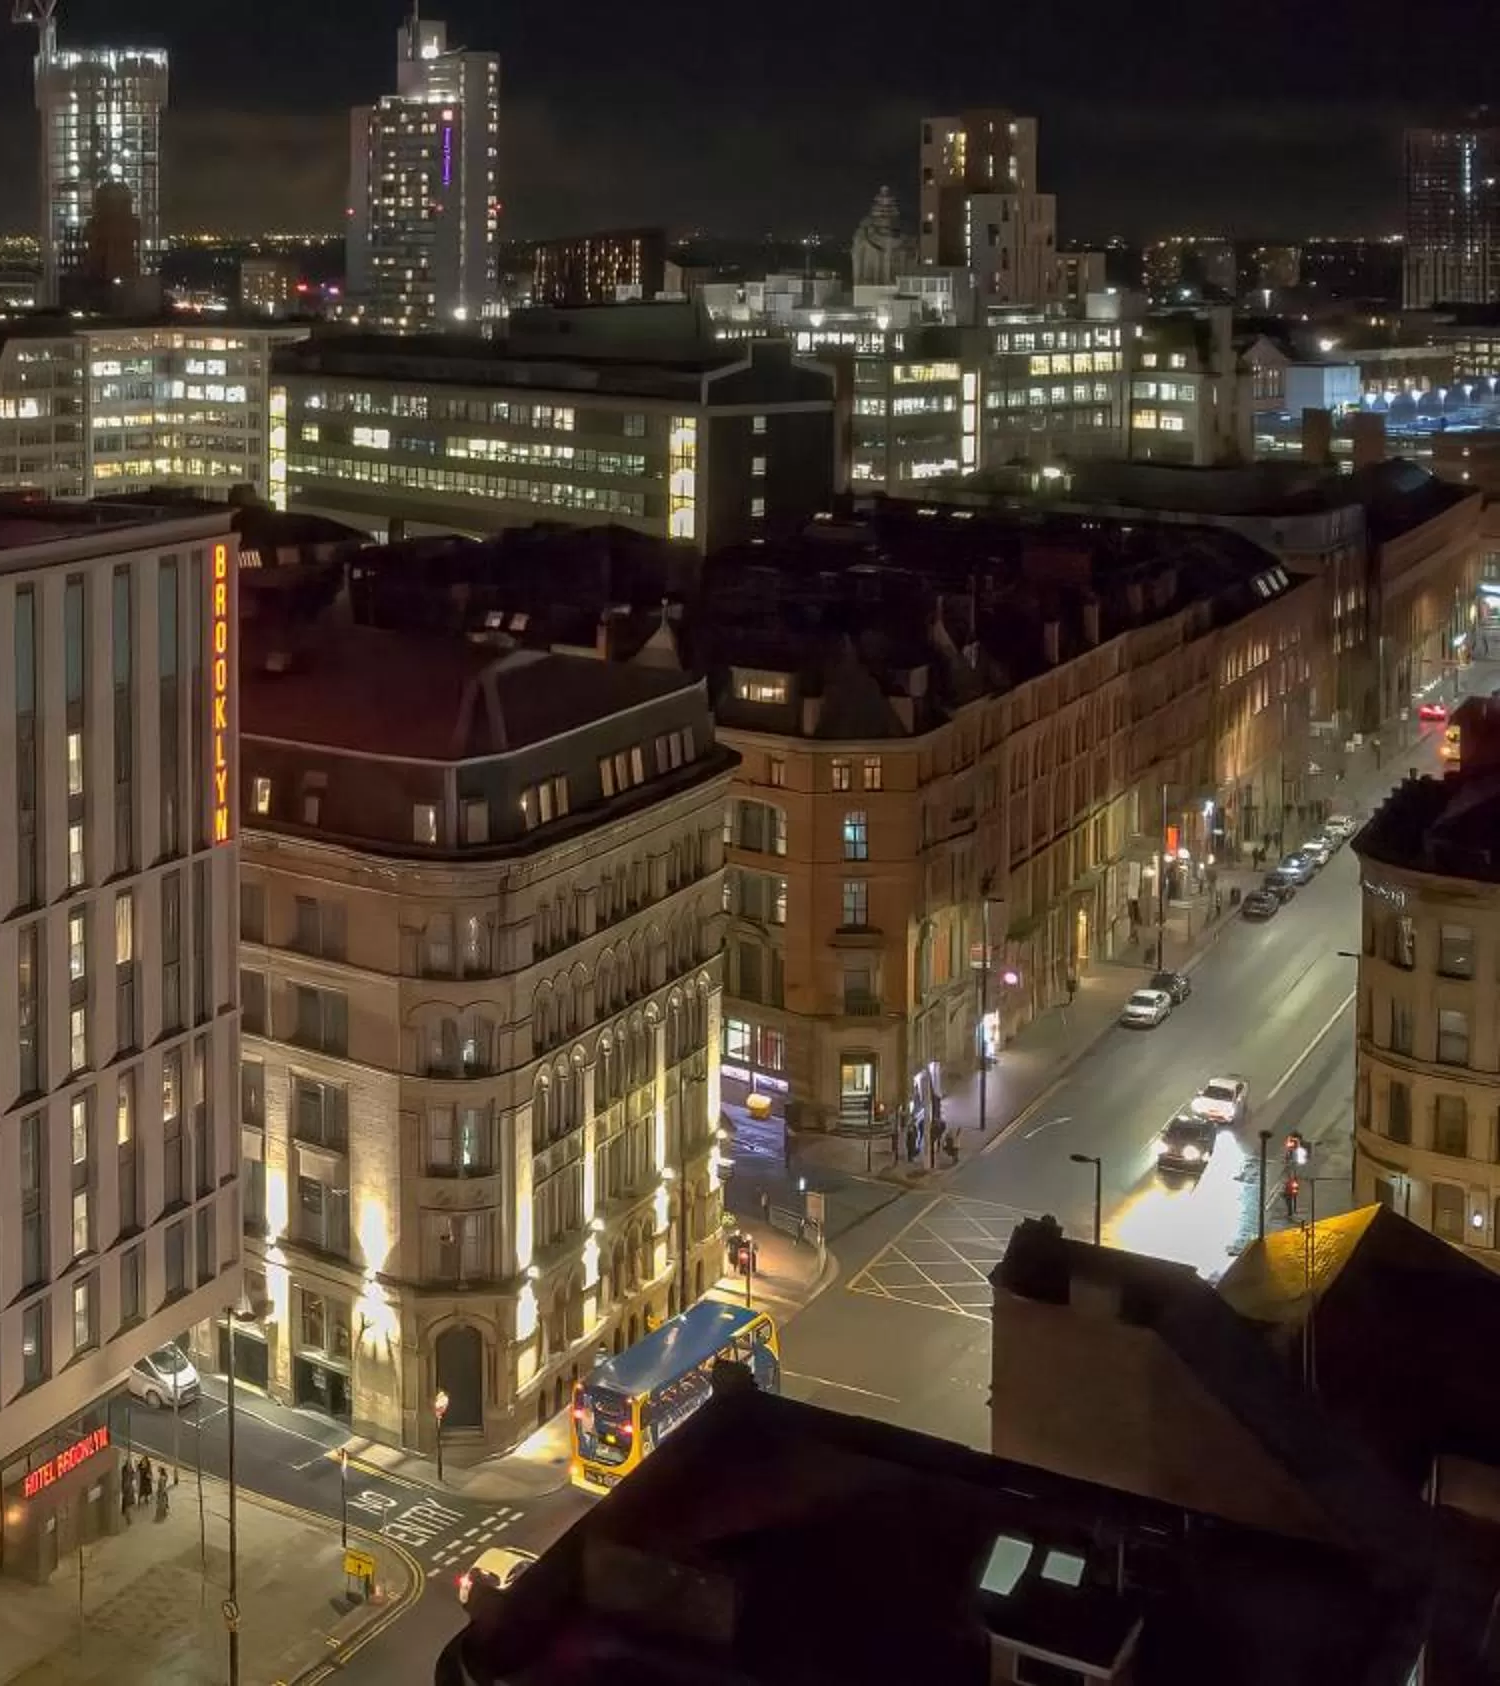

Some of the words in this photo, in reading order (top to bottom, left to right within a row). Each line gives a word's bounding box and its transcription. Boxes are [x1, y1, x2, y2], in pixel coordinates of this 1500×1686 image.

[214, 543, 229, 842] BROOKLYN
[24, 1460, 57, 1498] HOTEL
[57, 1425, 109, 1478] BROOKLYN
[379, 1497, 466, 1547] ENTRY
